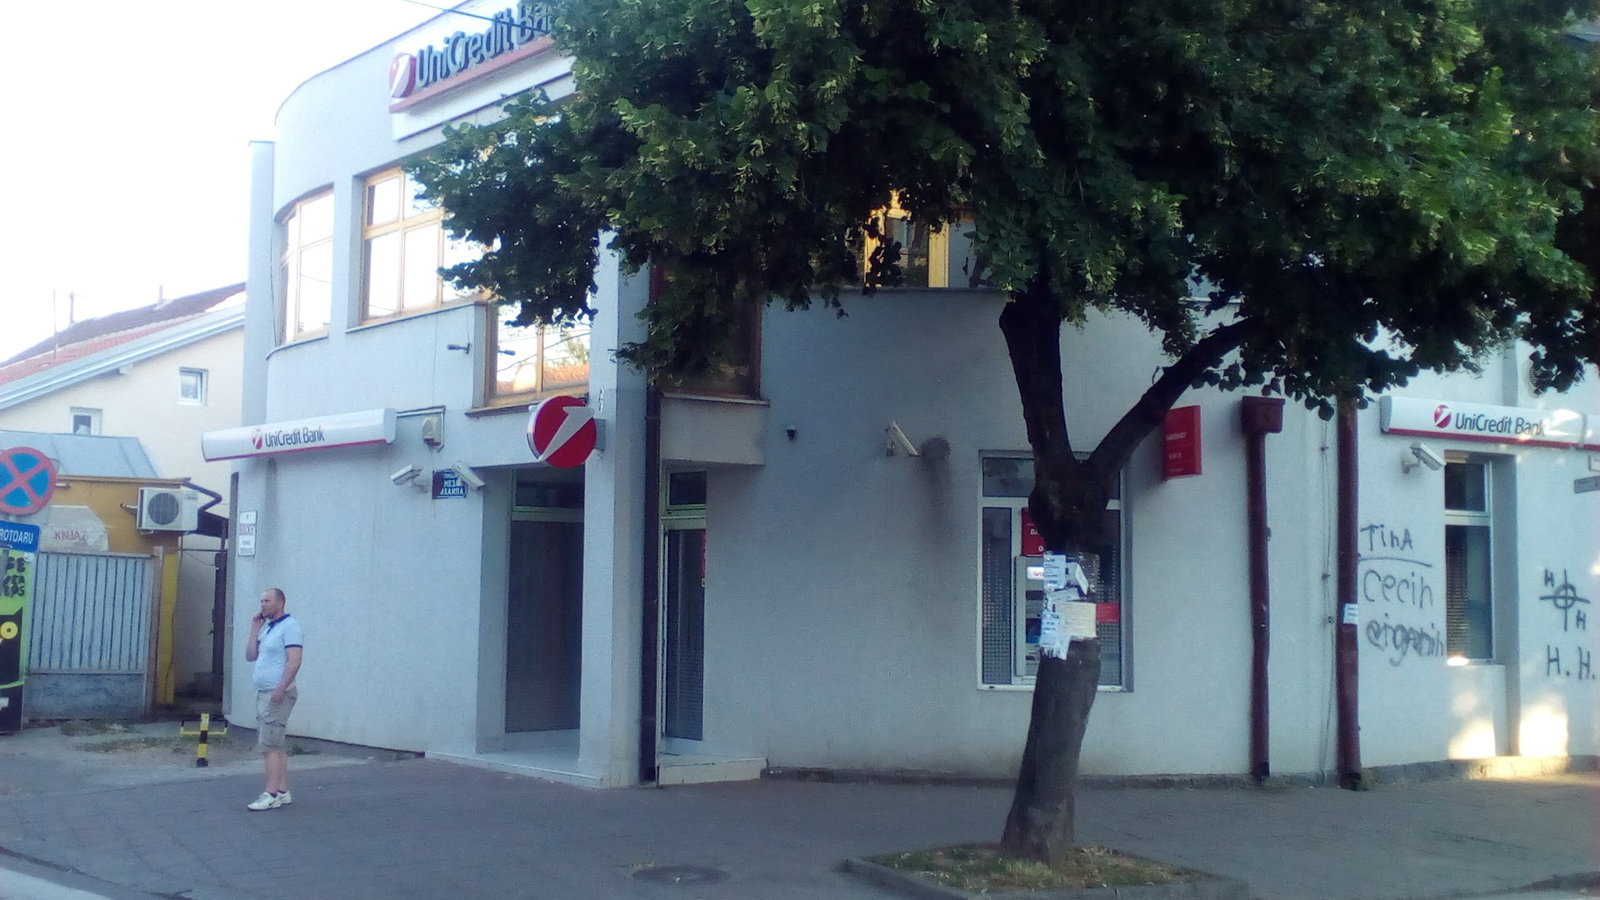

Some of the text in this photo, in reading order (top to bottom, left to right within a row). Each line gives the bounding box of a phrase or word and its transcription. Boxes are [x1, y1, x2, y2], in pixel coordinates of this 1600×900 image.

[416, 0, 551, 88] UniCredit Ba
[1455, 412, 1546, 436] UniCredit Bank
[265, 425, 325, 448] UniCredit Bank
[0, 528, 34, 544] ROTOARU
[1544, 568, 1555, 587] H
[1576, 609, 1587, 631] H
